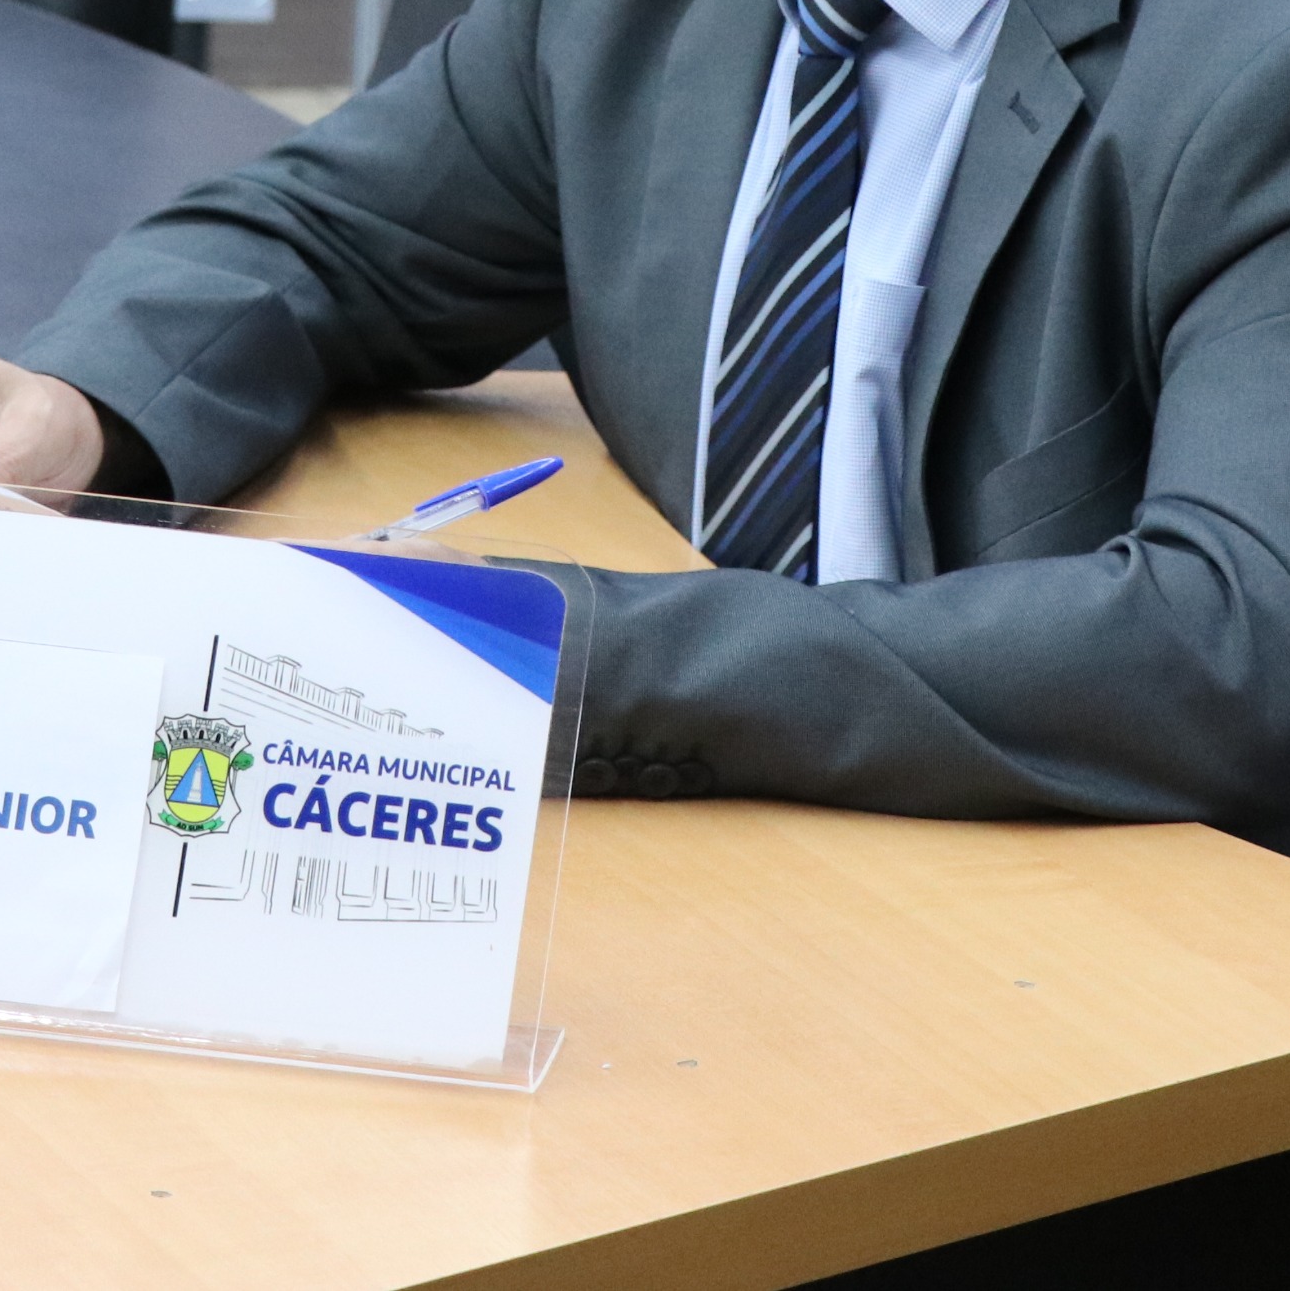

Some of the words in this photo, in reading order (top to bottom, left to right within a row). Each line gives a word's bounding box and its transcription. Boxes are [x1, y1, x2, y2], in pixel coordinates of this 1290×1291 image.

[262, 739, 370, 775] CÂMARA
[377, 756, 516, 792] MUNICIPAL
[262, 773, 504, 852] CÁCERES
